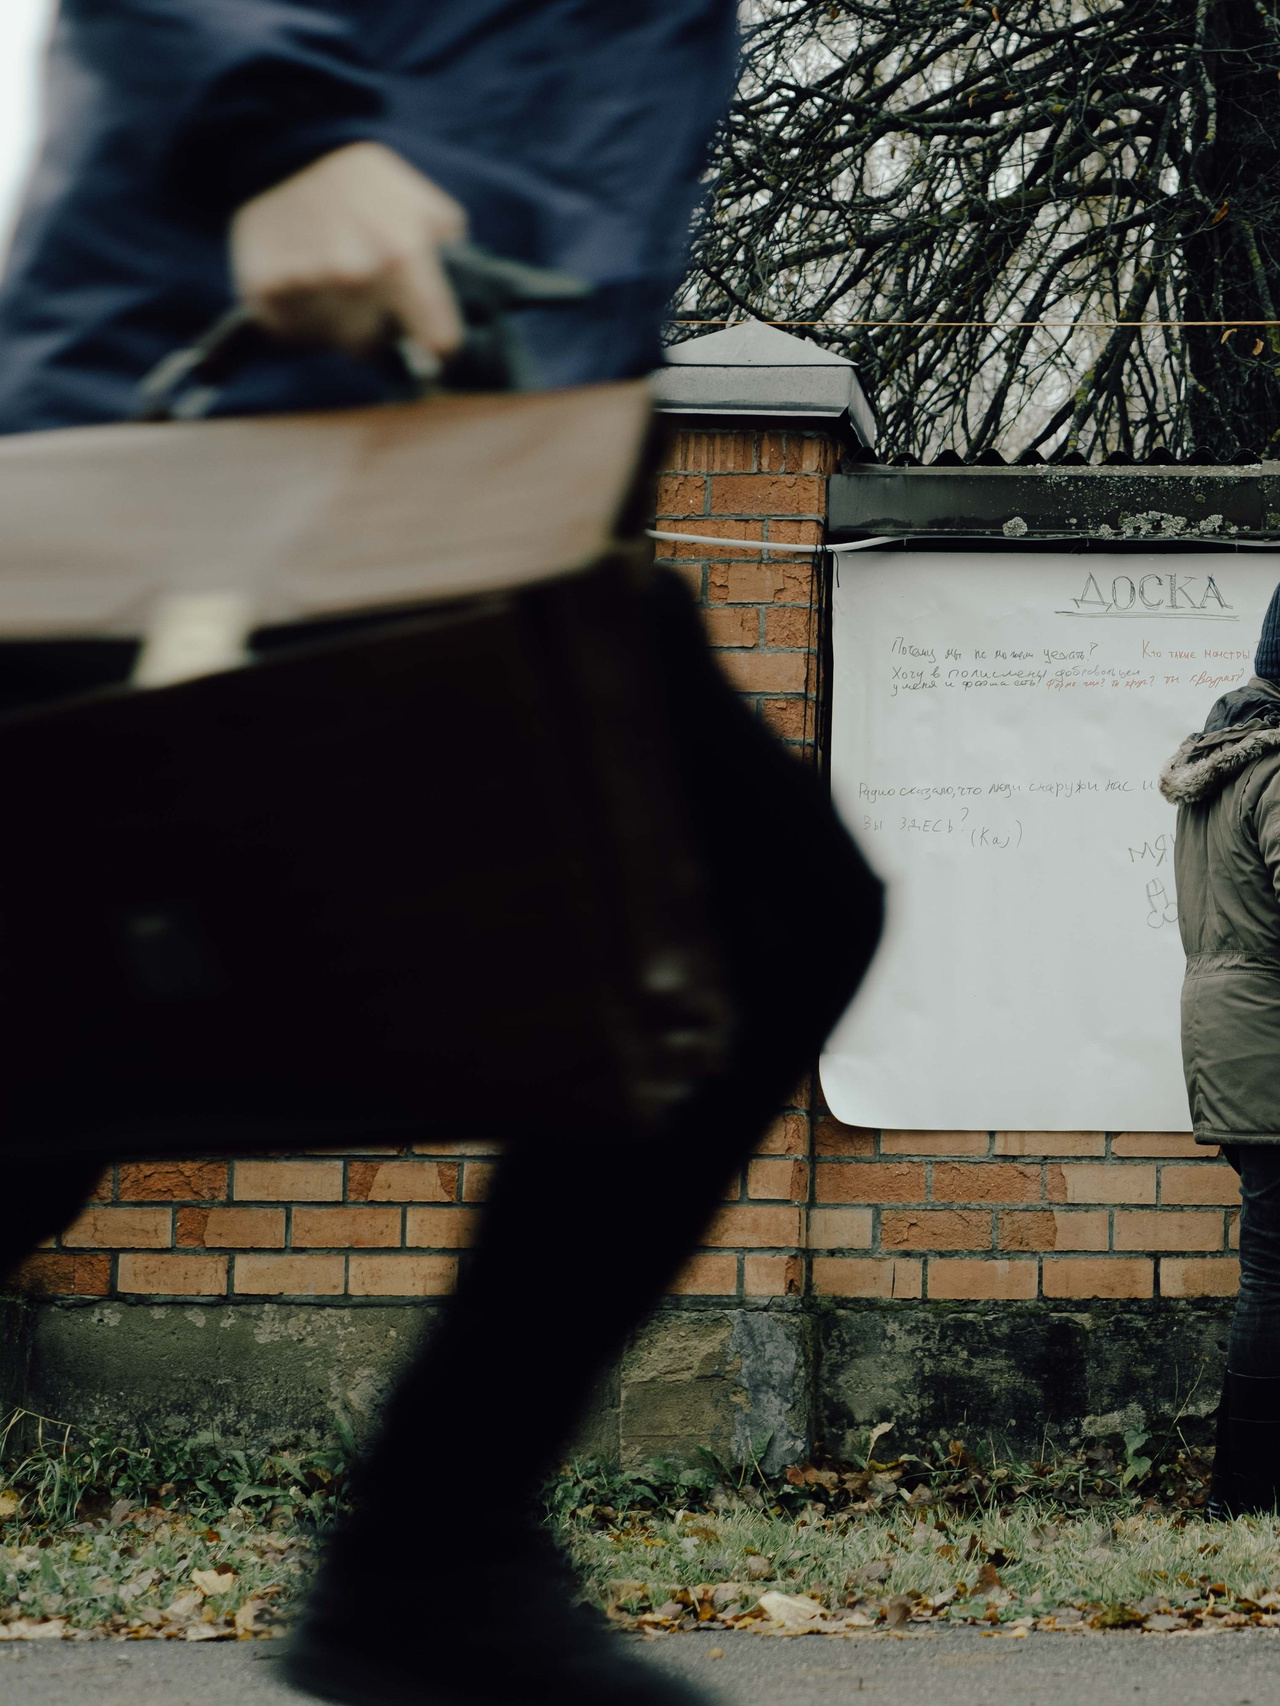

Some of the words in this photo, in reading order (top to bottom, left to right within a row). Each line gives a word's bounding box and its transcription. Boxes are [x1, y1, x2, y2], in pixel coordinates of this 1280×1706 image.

[1071, 572, 1234, 612] ДОСКА
[891, 637, 937, 664] Почему
[1142, 639, 1162, 659] Кто
[1168, 650, 1197, 660] такие
[892, 666, 924, 684] Хочу
[930, 666, 941, 679] в
[858, 782, 896, 804] Радио
[1028, 780, 1099, 798] снаружи
